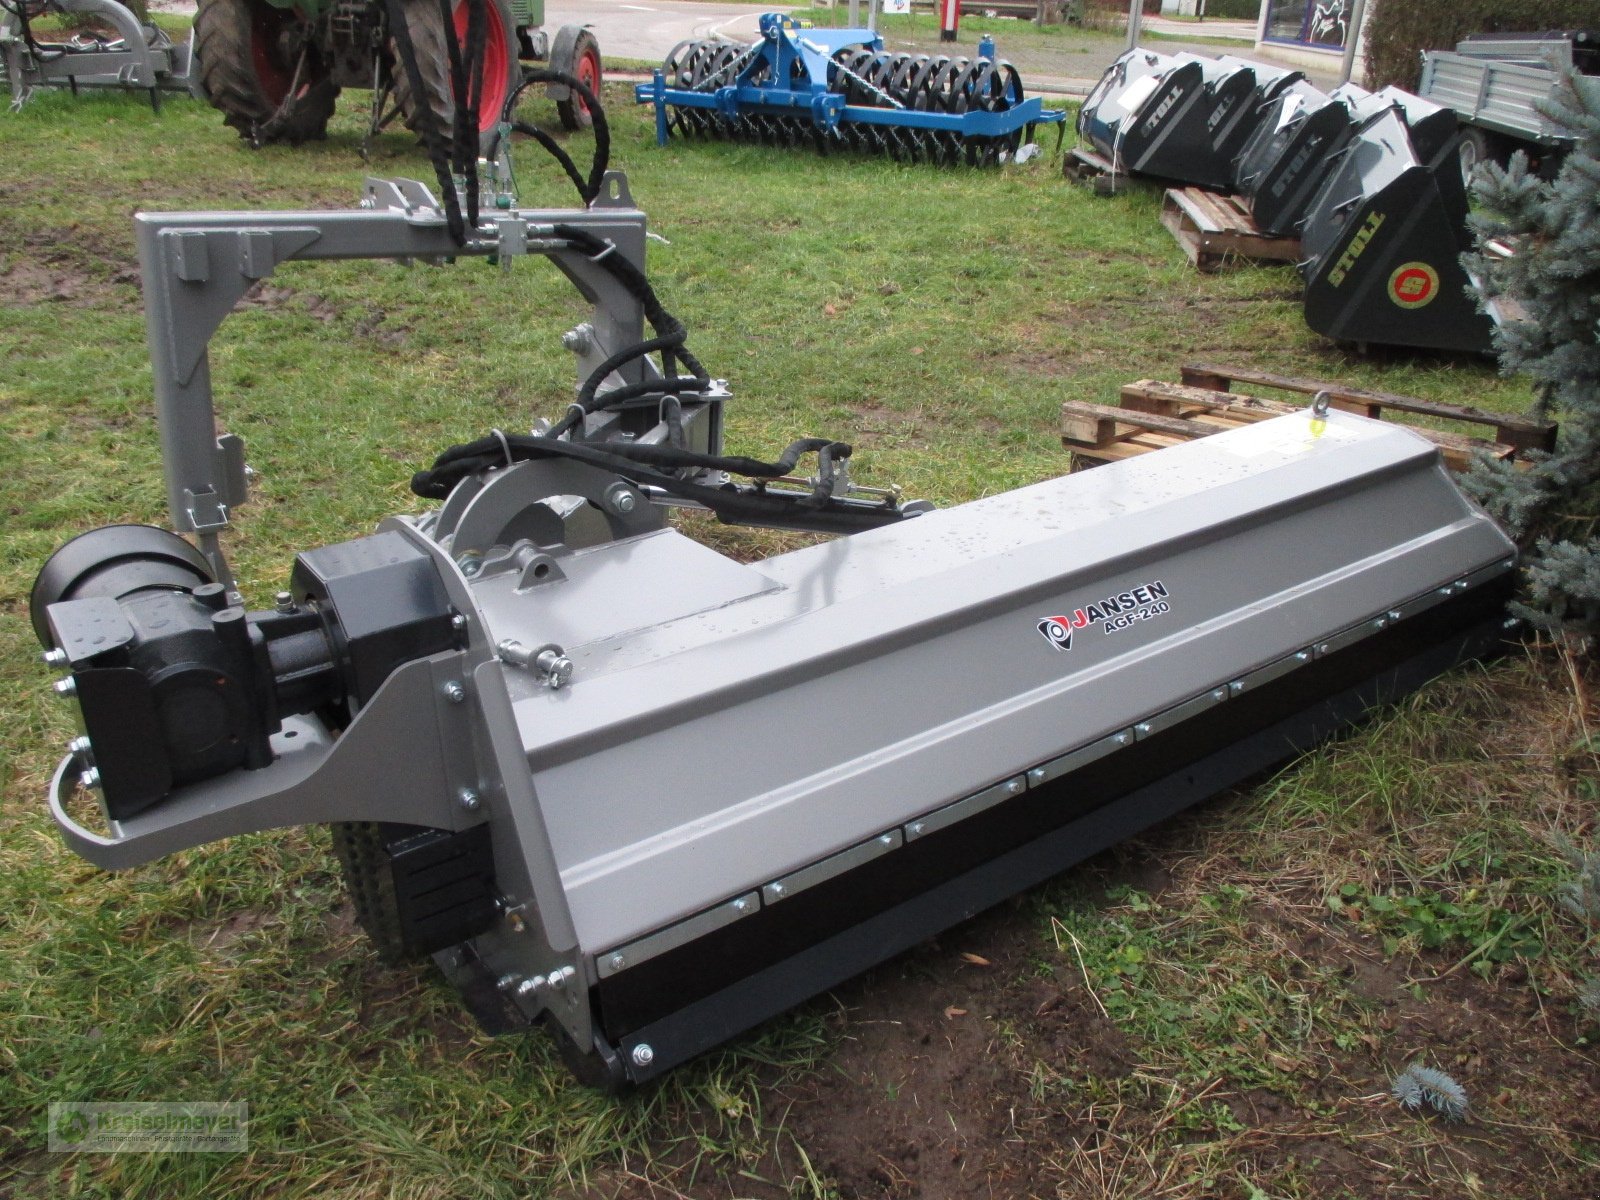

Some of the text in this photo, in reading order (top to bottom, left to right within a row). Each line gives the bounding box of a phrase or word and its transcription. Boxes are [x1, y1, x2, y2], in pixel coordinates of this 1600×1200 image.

[1140, 84, 1183, 137] STOLL
[1327, 210, 1386, 288] STOLL
[1072, 580, 1169, 628] JANSEN
[1104, 602, 1169, 634] AGF-240
